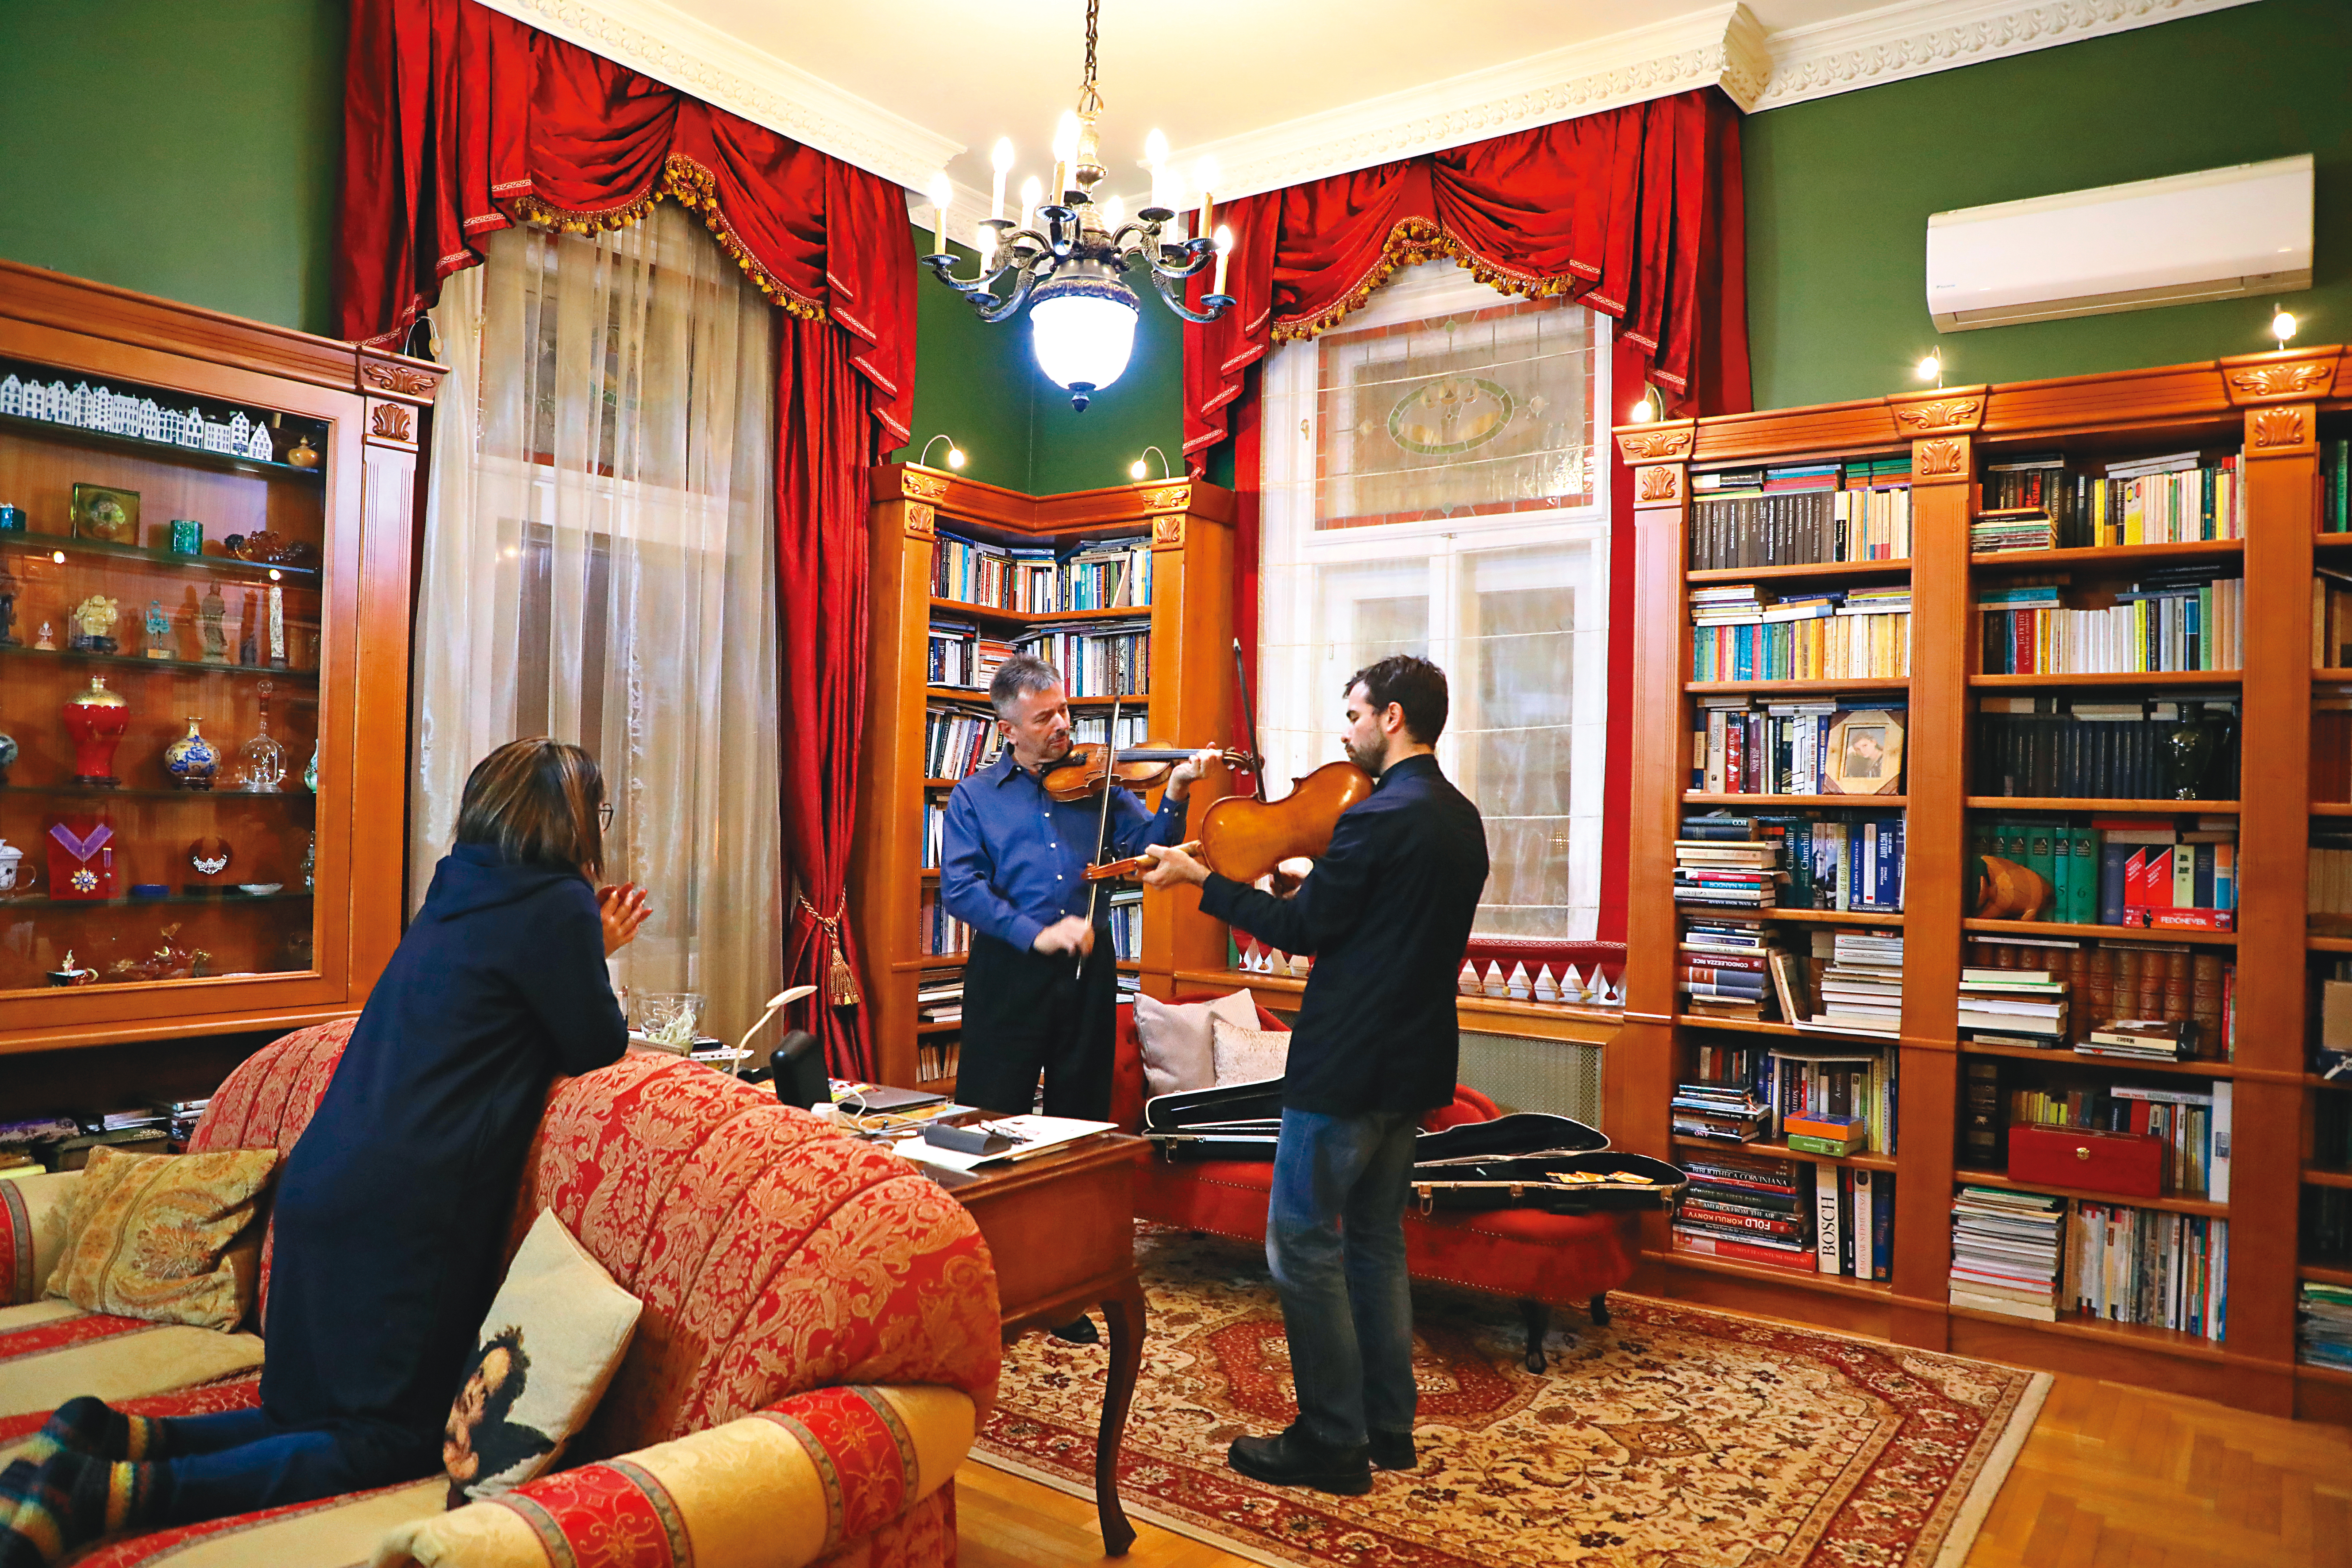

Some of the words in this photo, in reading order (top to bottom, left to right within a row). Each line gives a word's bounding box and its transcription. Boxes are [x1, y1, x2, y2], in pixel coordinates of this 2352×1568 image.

[2077, 888, 2086, 898] 6
[1693, 1167, 1738, 1179] BIBLIOTHECA
[1740, 1174, 1787, 1187] CORVINIANA
[1703, 1202, 1729, 1212] AMERICA
[1688, 1211, 1713, 1221] KÖNYV
[1745, 1218, 1771, 1231] FÖLD
[1821, 1196, 1836, 1256] BOSCH
